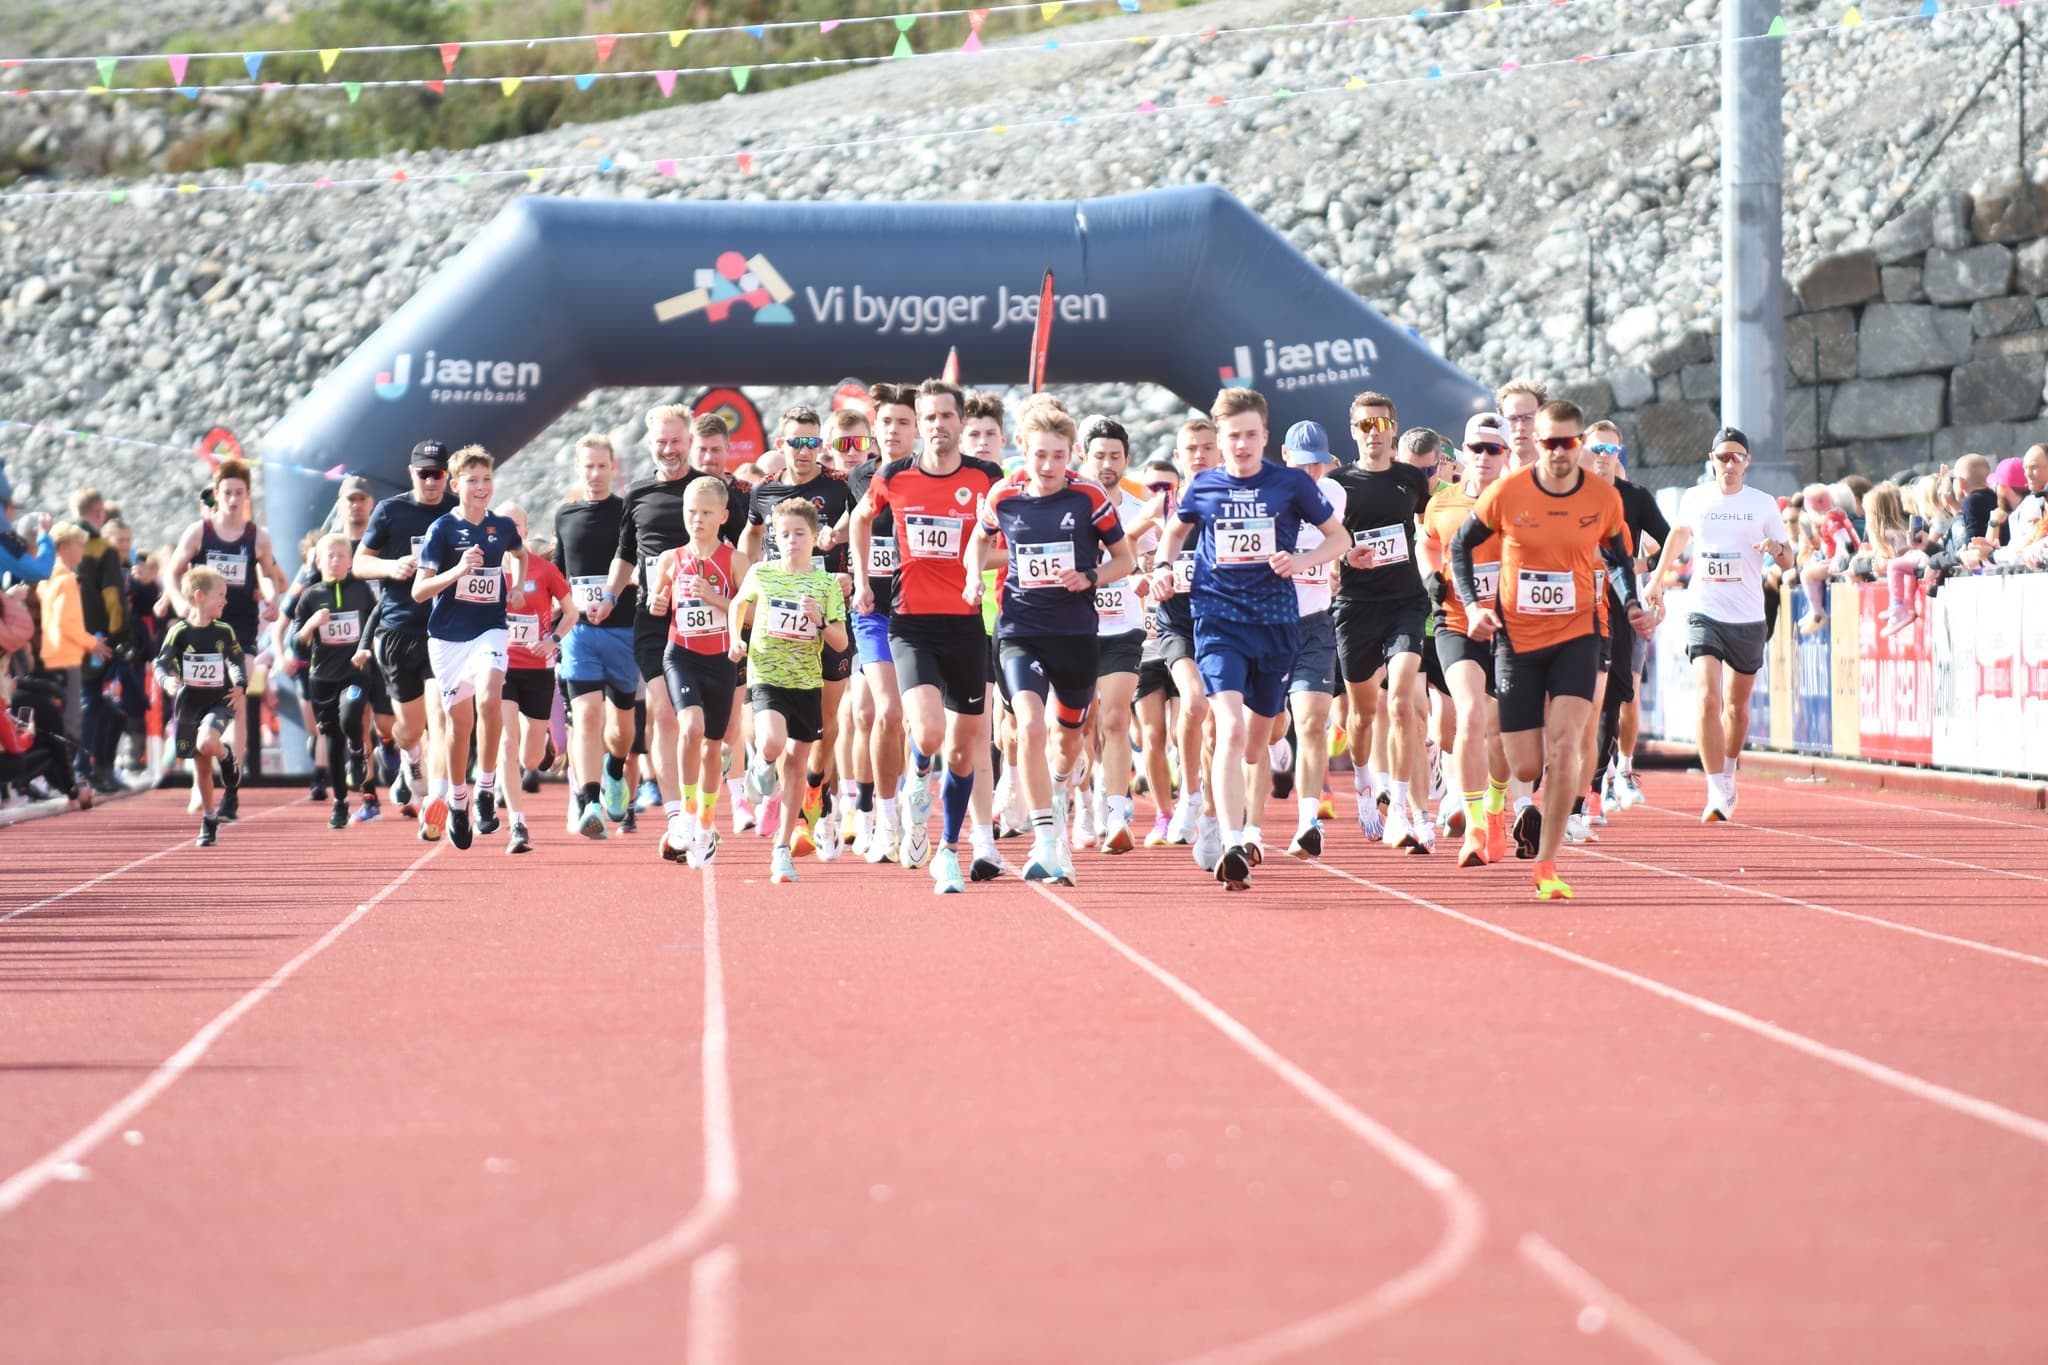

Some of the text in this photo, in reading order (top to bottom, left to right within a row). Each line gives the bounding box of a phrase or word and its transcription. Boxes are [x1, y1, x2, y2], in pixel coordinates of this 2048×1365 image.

[805, 285, 1107, 333] Vi bygger Jæen
[1263, 337, 1379, 377] jæren
[420, 349, 542, 387] jæren
[1276, 363, 1372, 390] sparebank
[430, 388, 527, 403] sparebank
[1220, 502, 1268, 518] TINE
[918, 529, 948, 548] 140
[1228, 534, 1261, 553] 728
[1029, 557, 1062, 578] 615
[1708, 561, 1730, 576] 611
[468, 578, 494, 595] 690
[1471, 575, 1490, 593] 21
[580, 586, 603, 602] 739
[1095, 591, 1122, 608] 632
[1531, 585, 1564, 605] 606
[687, 610, 714, 627] 581
[780, 612, 810, 633] 712
[328, 622, 352, 637] 510
[512, 625, 529, 640] 17
[191, 664, 216, 679] 722
